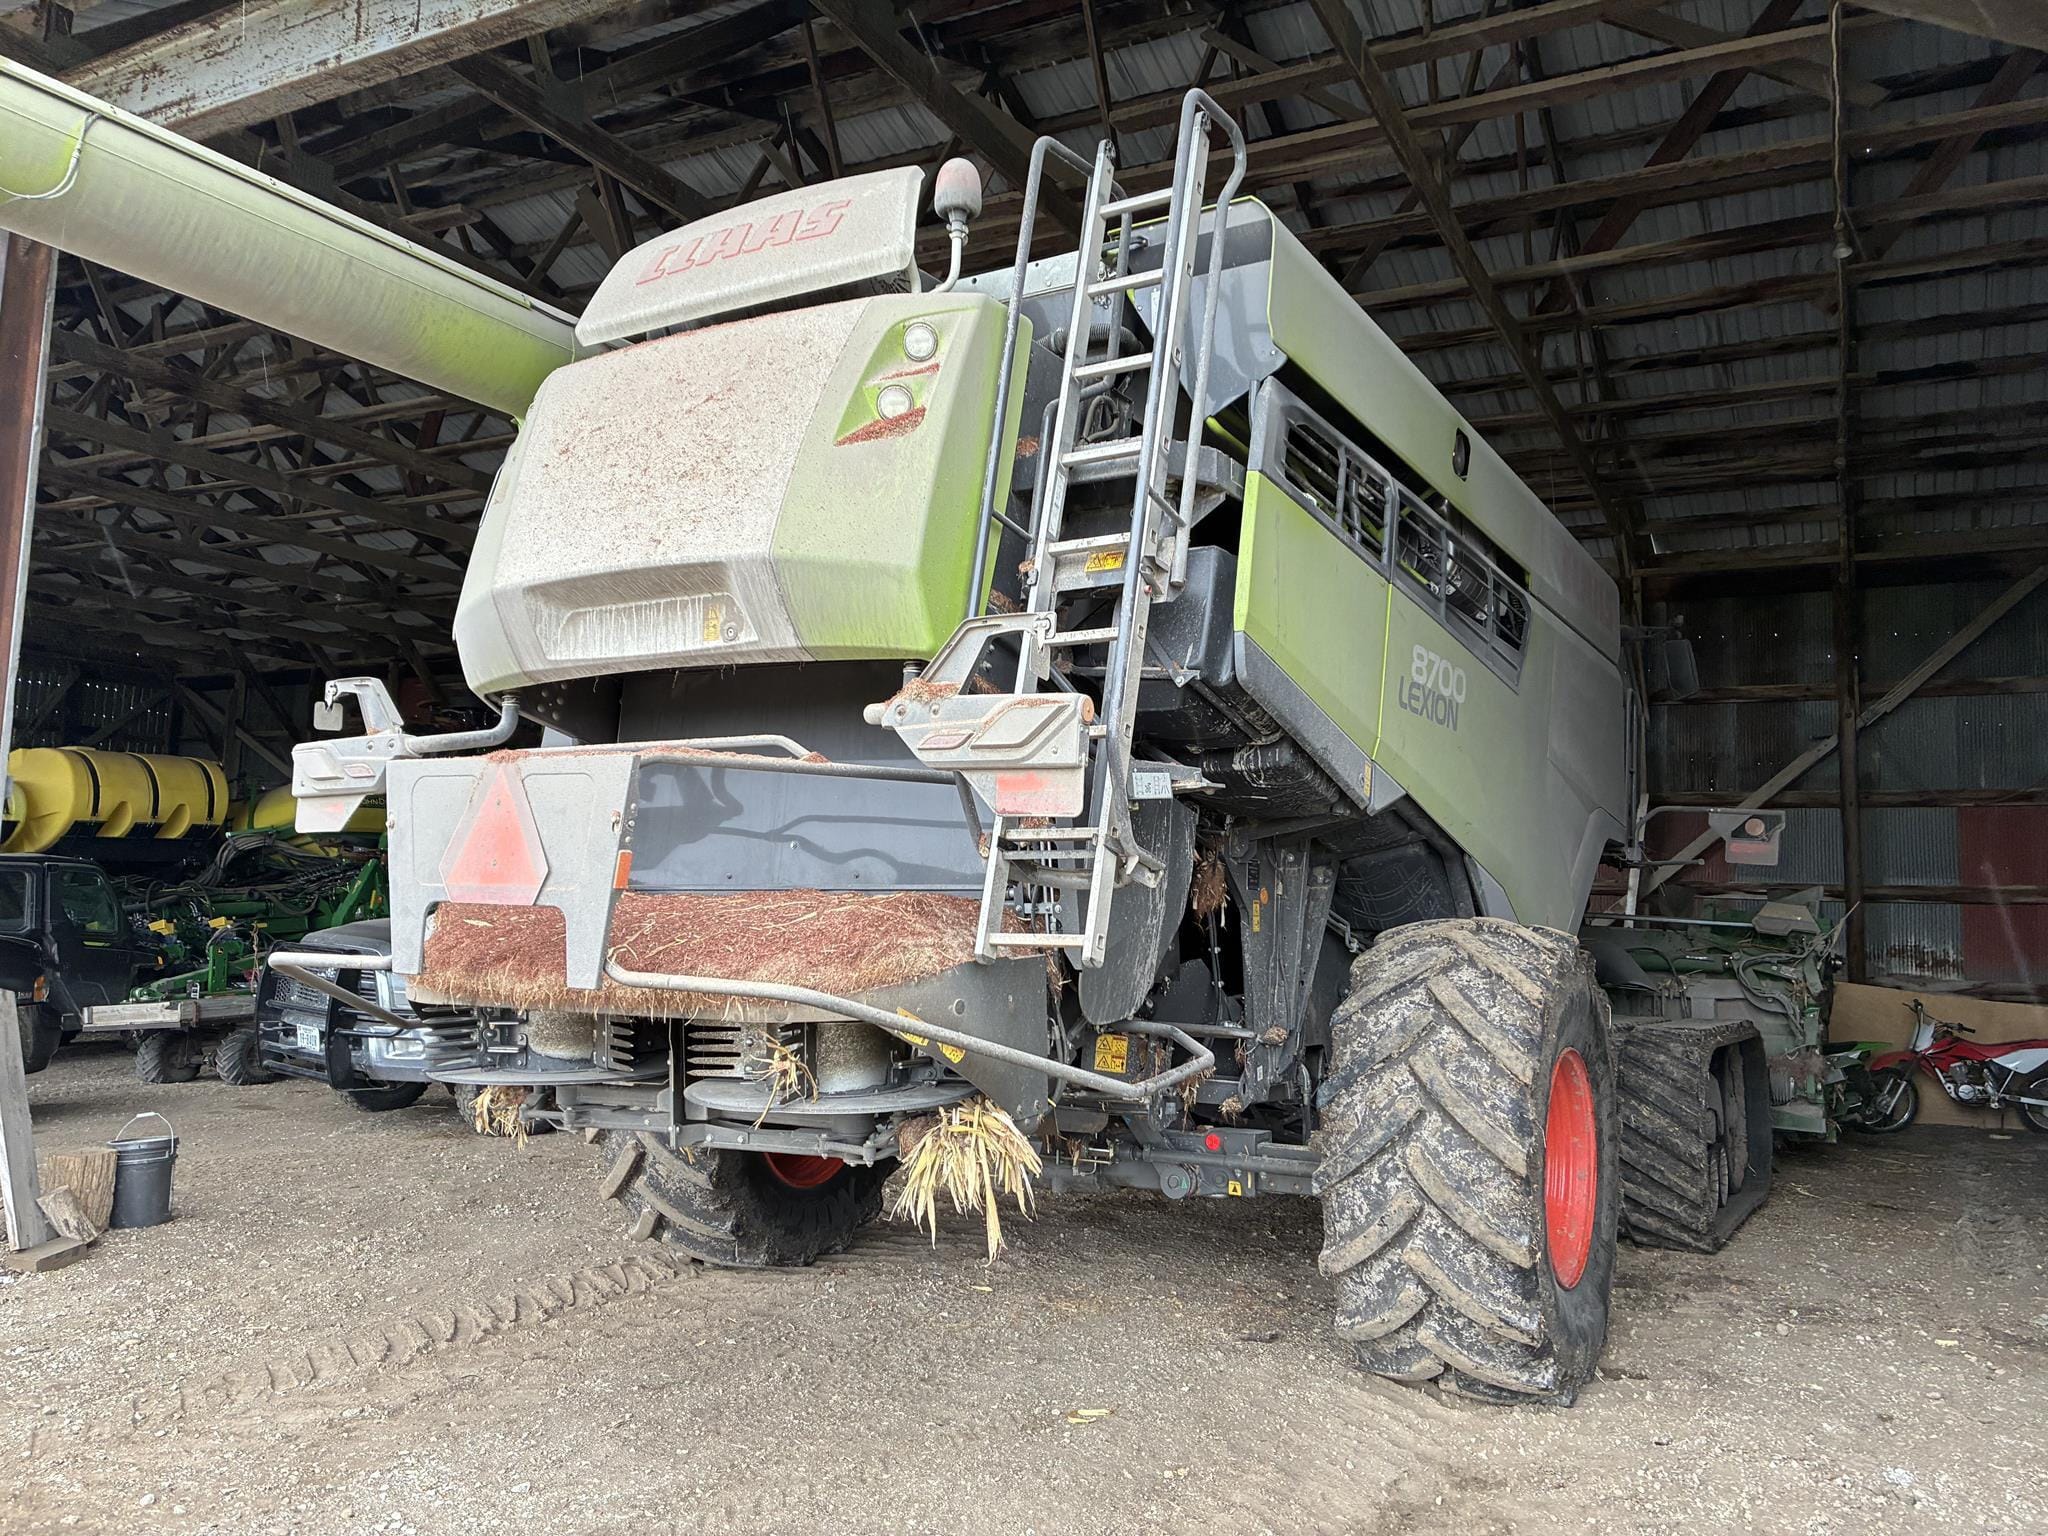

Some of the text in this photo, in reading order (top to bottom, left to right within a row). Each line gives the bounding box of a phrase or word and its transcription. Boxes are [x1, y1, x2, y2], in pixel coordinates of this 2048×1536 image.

[636, 199, 852, 286] CLAAS
[1399, 675, 1459, 731] LEXION
[1412, 644, 1466, 704] 8700
